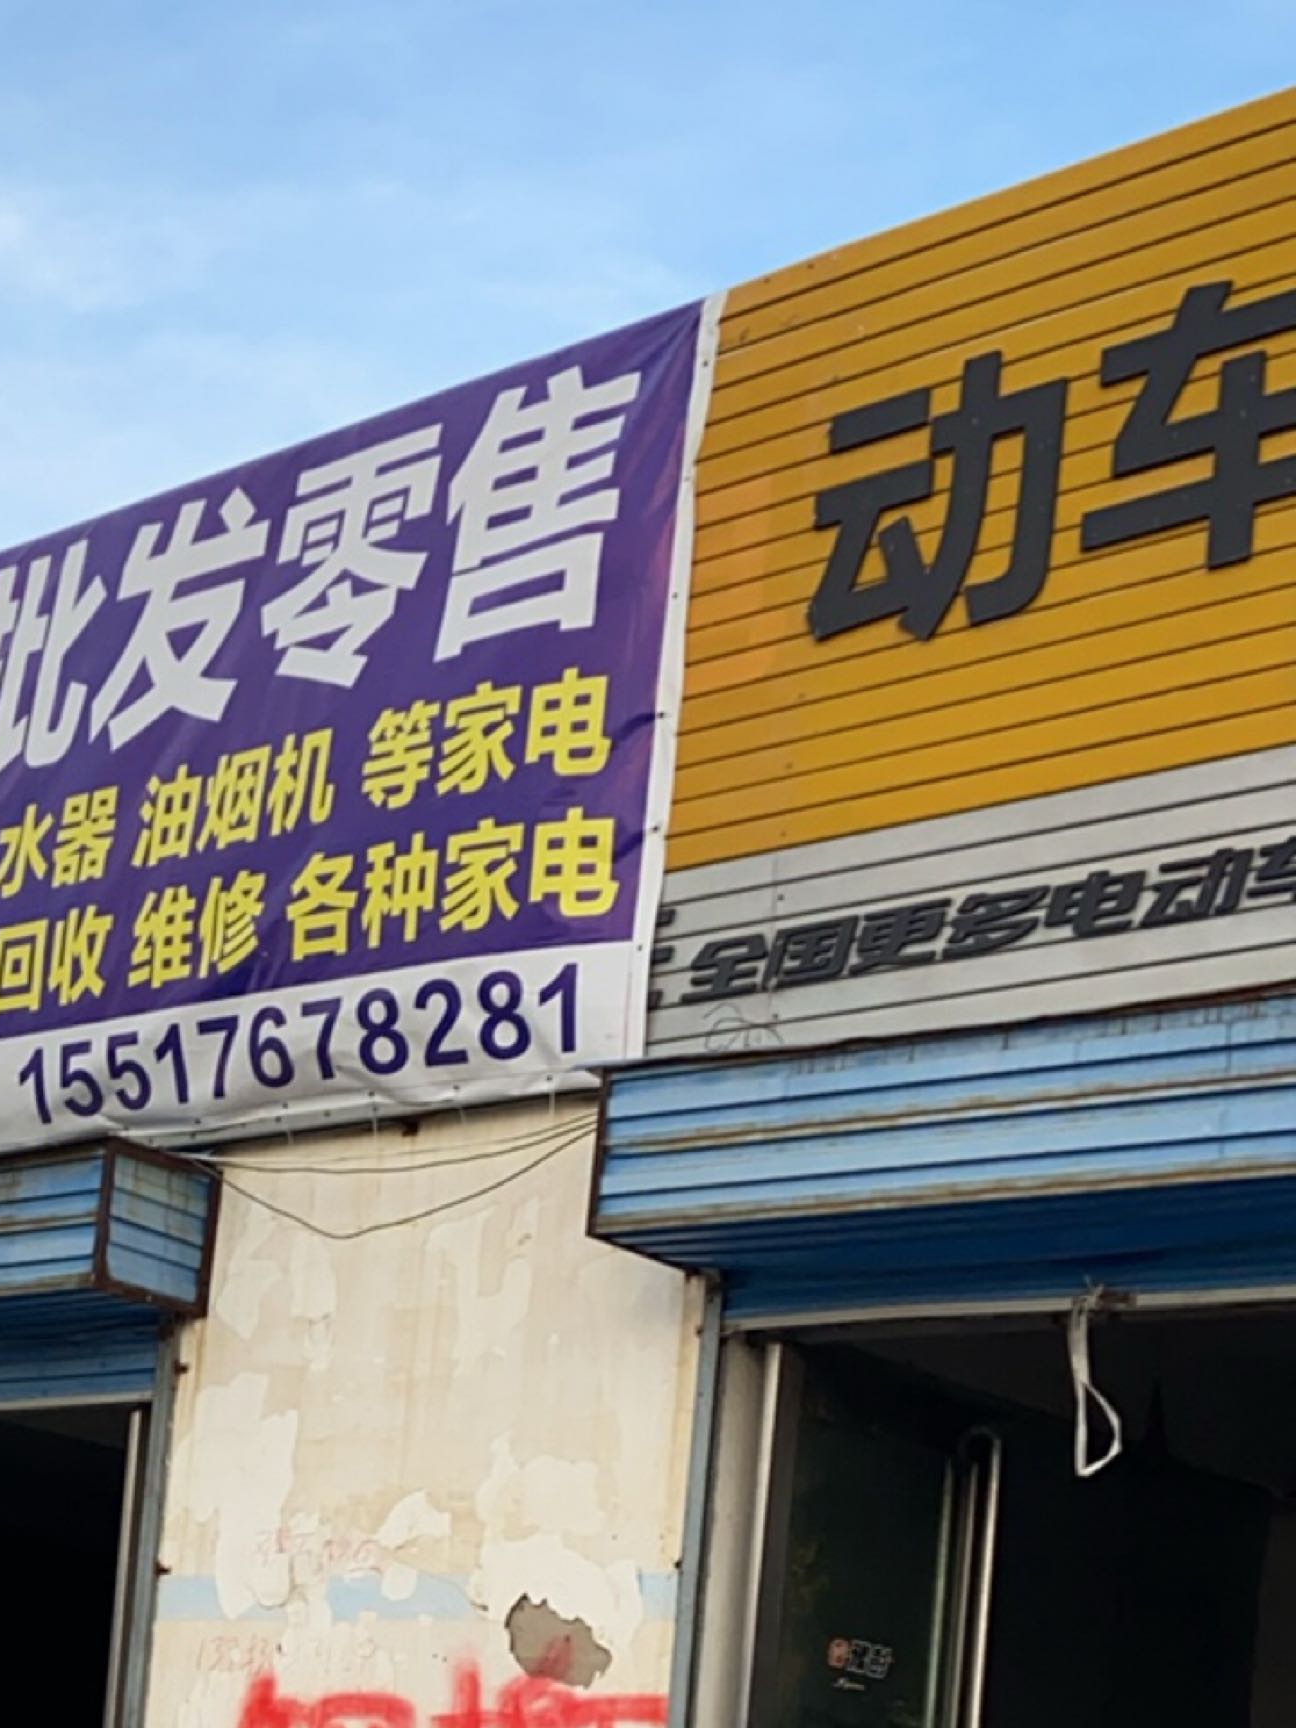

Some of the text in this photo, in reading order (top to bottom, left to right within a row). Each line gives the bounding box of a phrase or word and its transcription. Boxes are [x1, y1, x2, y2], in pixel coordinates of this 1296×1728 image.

[807, 280, 1296, 643] 动车
[131, 727, 335, 867] 油烟机
[361, 667, 612, 810] 等家电
[126, 869, 266, 991] 维修
[286, 807, 620, 964] 各种家电
[19, 962, 579, 1126] 15517678281
